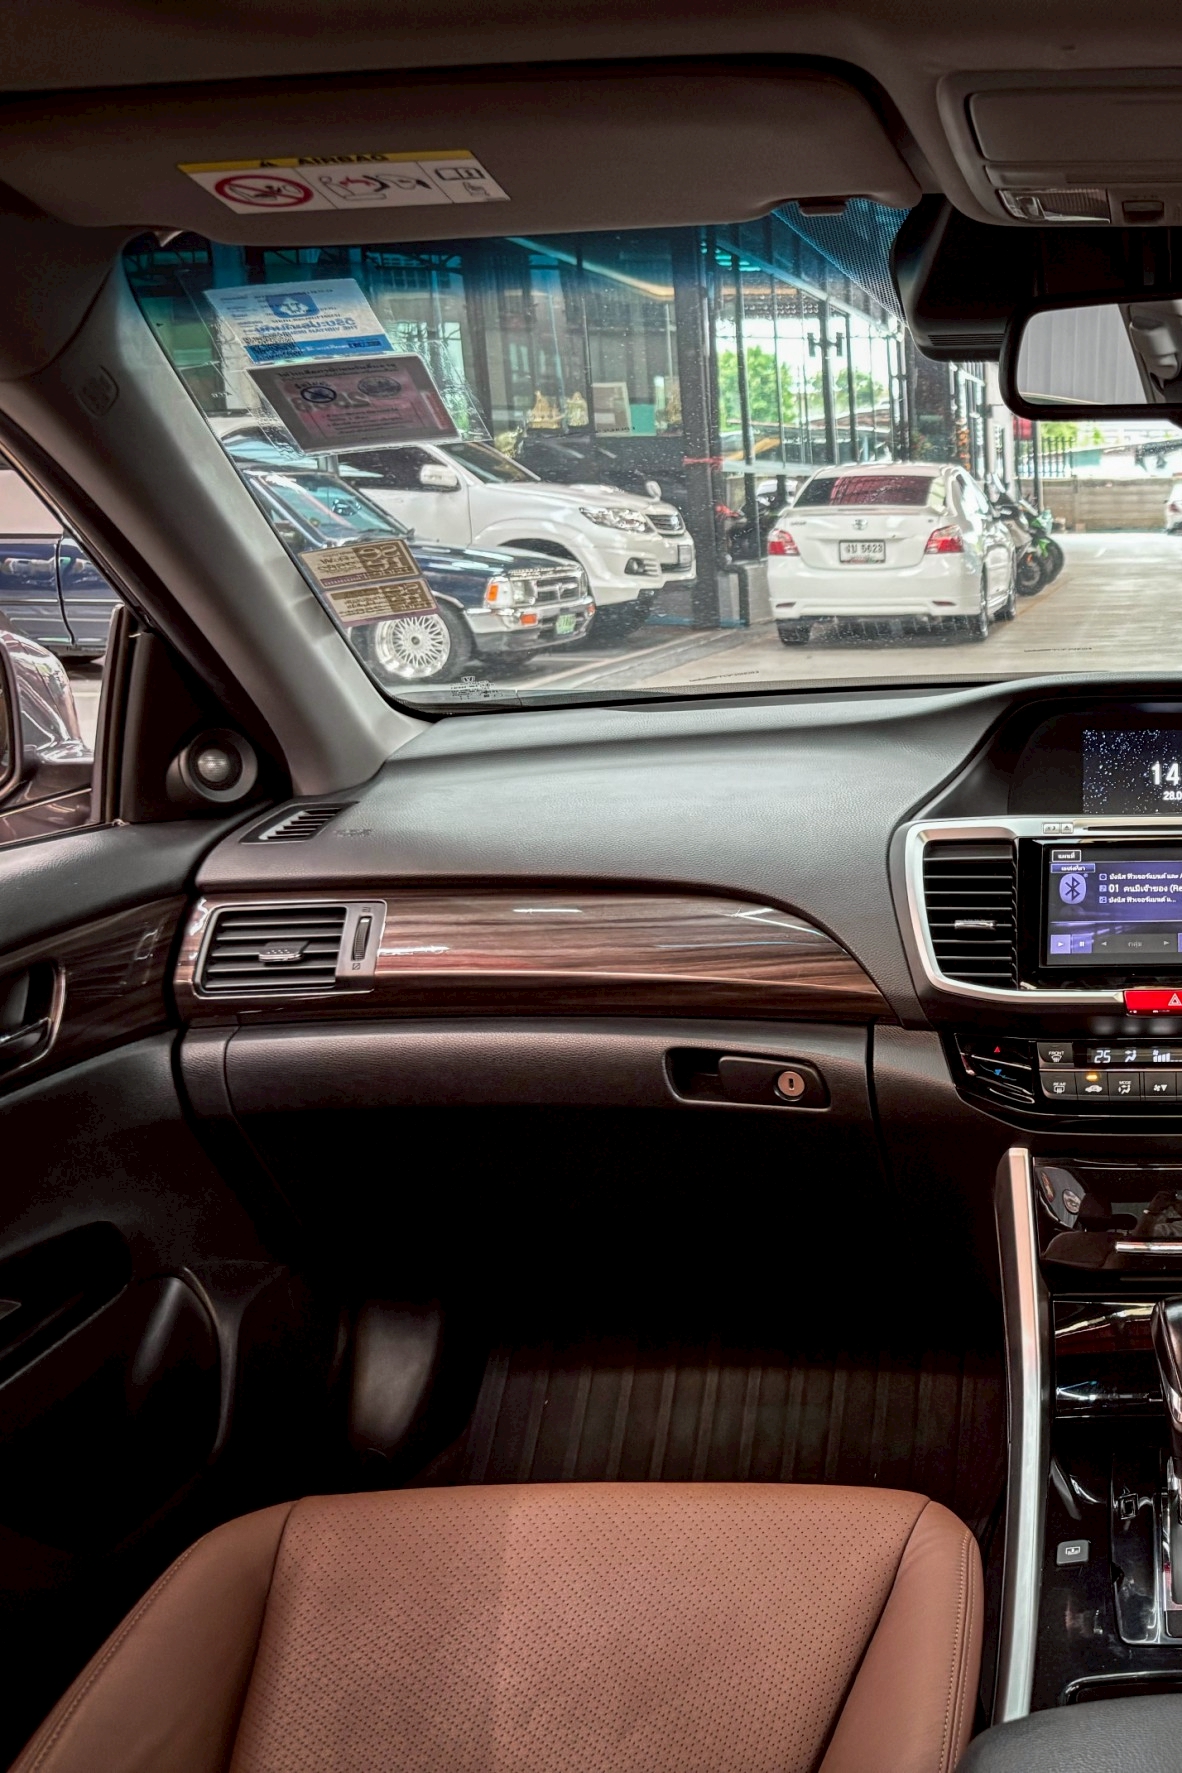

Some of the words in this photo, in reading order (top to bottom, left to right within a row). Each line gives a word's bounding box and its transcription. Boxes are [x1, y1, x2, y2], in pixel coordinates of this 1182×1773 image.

[1150, 761, 1181, 786] 14
[1108, 884, 1119, 893] 01
[1094, 1049, 1111, 1064] 25
